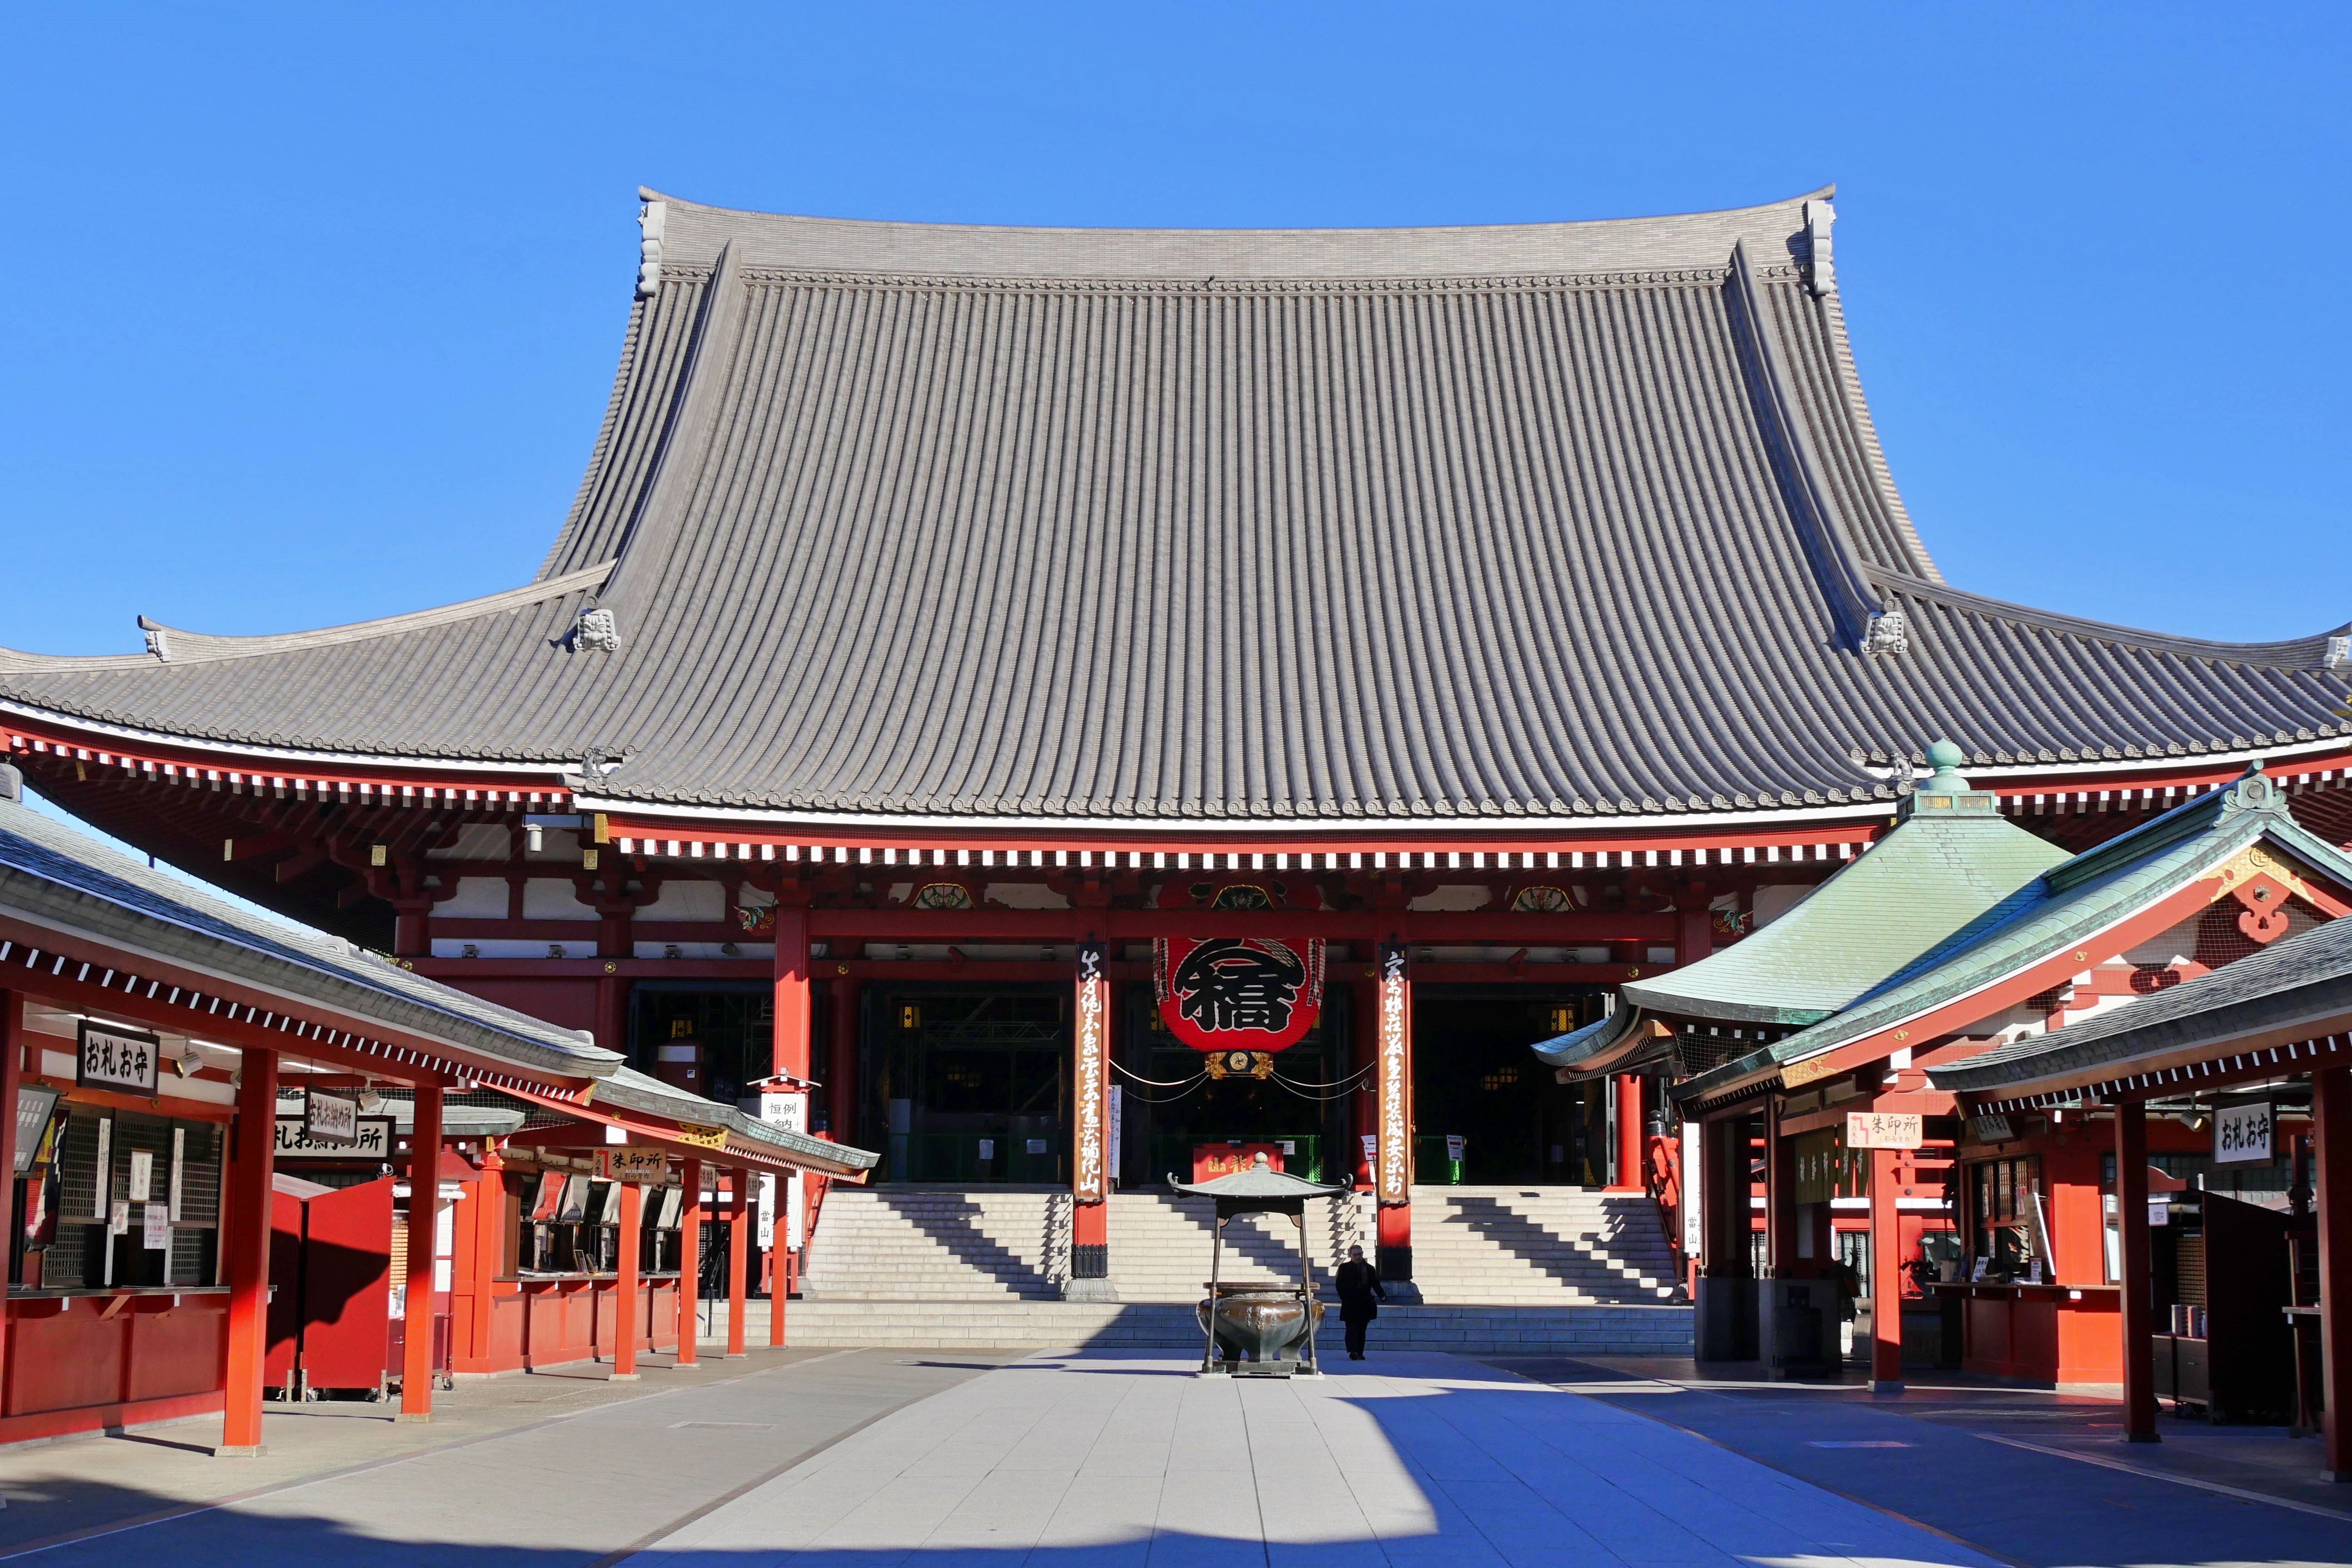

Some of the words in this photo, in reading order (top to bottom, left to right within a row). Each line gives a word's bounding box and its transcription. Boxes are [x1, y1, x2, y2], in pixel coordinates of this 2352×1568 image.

[87, 1036, 148, 1083] お札お守
[310, 1098, 351, 1131] 古札お納め所
[769, 1102, 796, 1115] 恒例
[1872, 1114, 1918, 1136] 朱印所
[2222, 1113, 2269, 1151] お札お守
[613, 1152, 662, 1170] 朱印所
[761, 1210, 770, 1238] 當山
[1688, 1217, 1697, 1244] 當山
